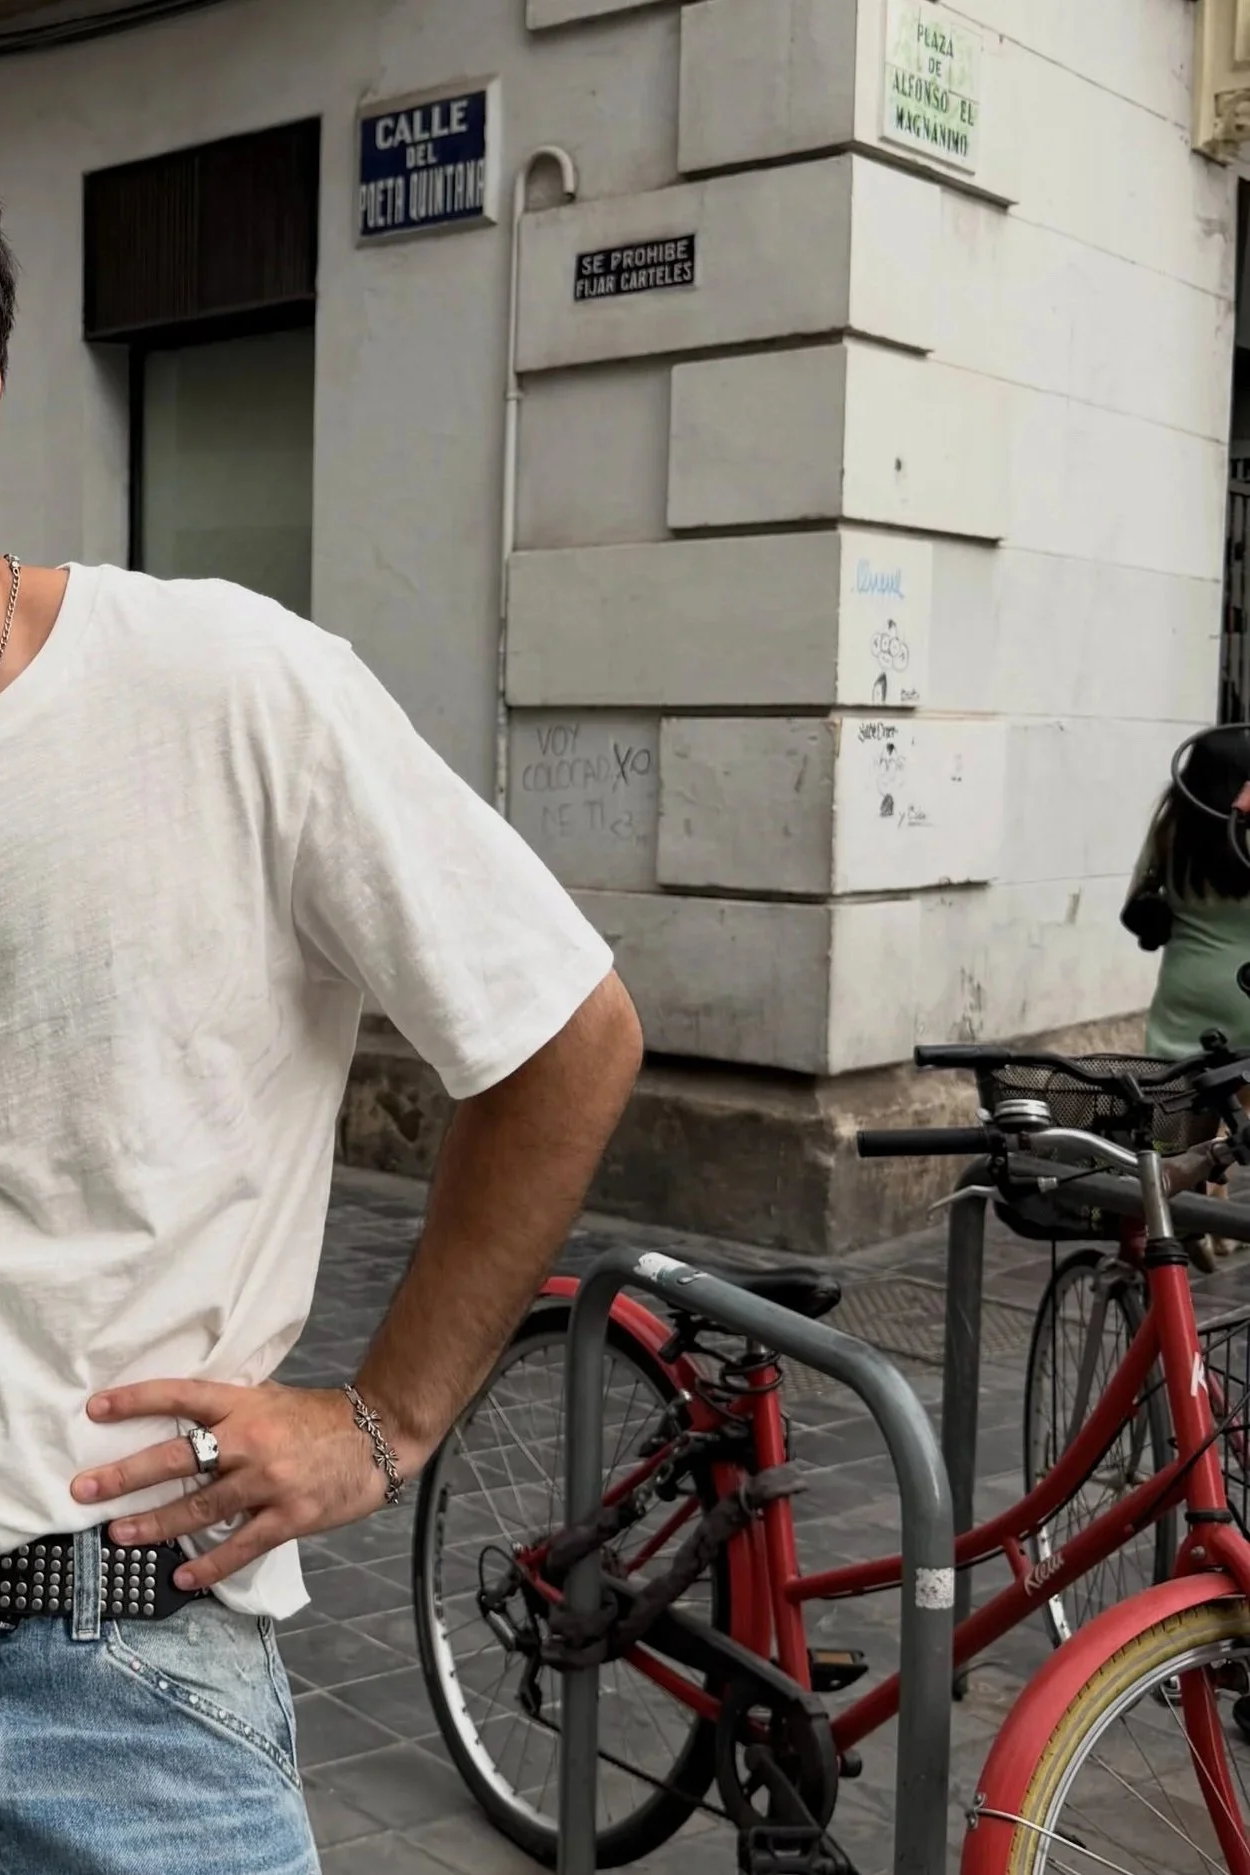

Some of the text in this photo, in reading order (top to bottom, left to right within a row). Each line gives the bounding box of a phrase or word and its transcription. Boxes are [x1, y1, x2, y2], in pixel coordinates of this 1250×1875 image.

[917, 23, 954, 58] PLAZA
[928, 57, 942, 77] DE
[892, 69, 974, 126] ALFONSO EL
[375, 100, 468, 150] CALLE
[406, 142, 437, 168] DEL
[358, 158, 485, 229] POETA QUINTANA
[581, 239, 689, 275] SE PROHIBE
[575, 261, 693, 298] FIJAR CARTELES
[536, 722, 580, 757] VOY
